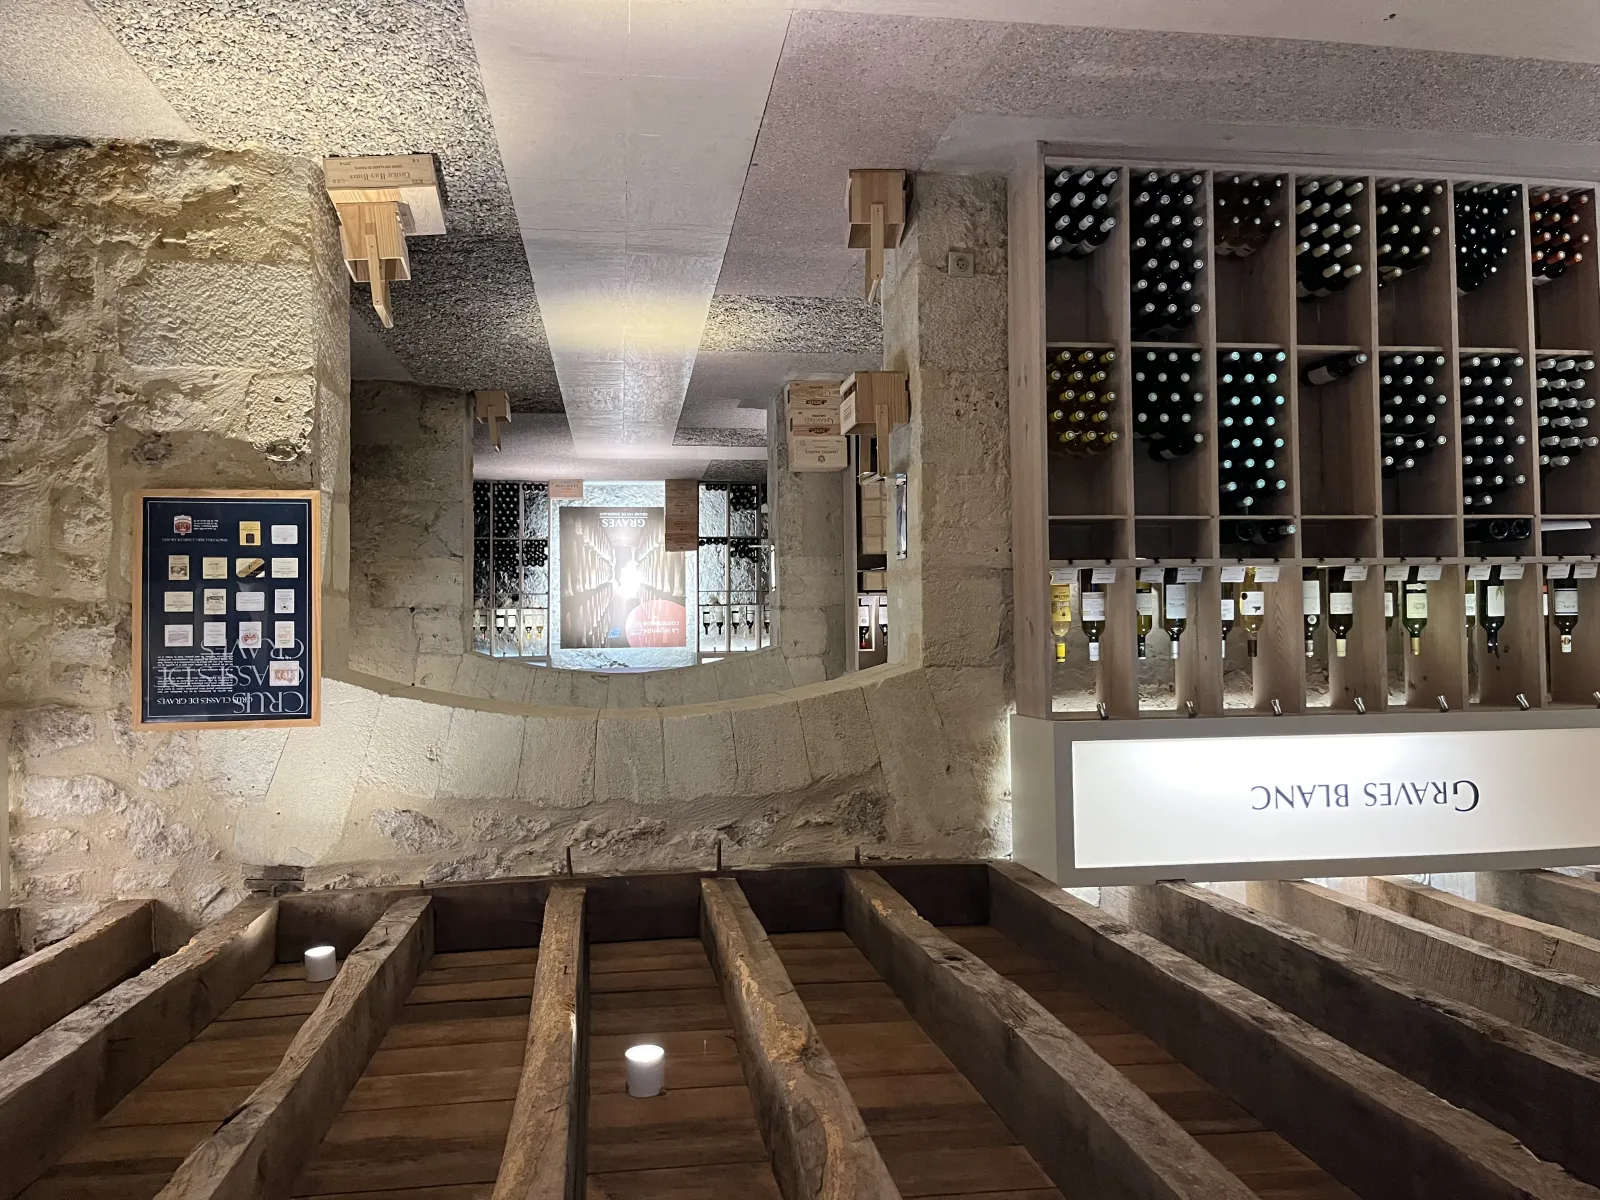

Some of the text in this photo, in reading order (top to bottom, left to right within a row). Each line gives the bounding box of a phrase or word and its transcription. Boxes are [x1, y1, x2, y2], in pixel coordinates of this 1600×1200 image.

[602, 518, 646, 528] GRAVES
[232, 691, 304, 714] CRUS
[1250, 780, 1480, 812] GRAVES BLANC
